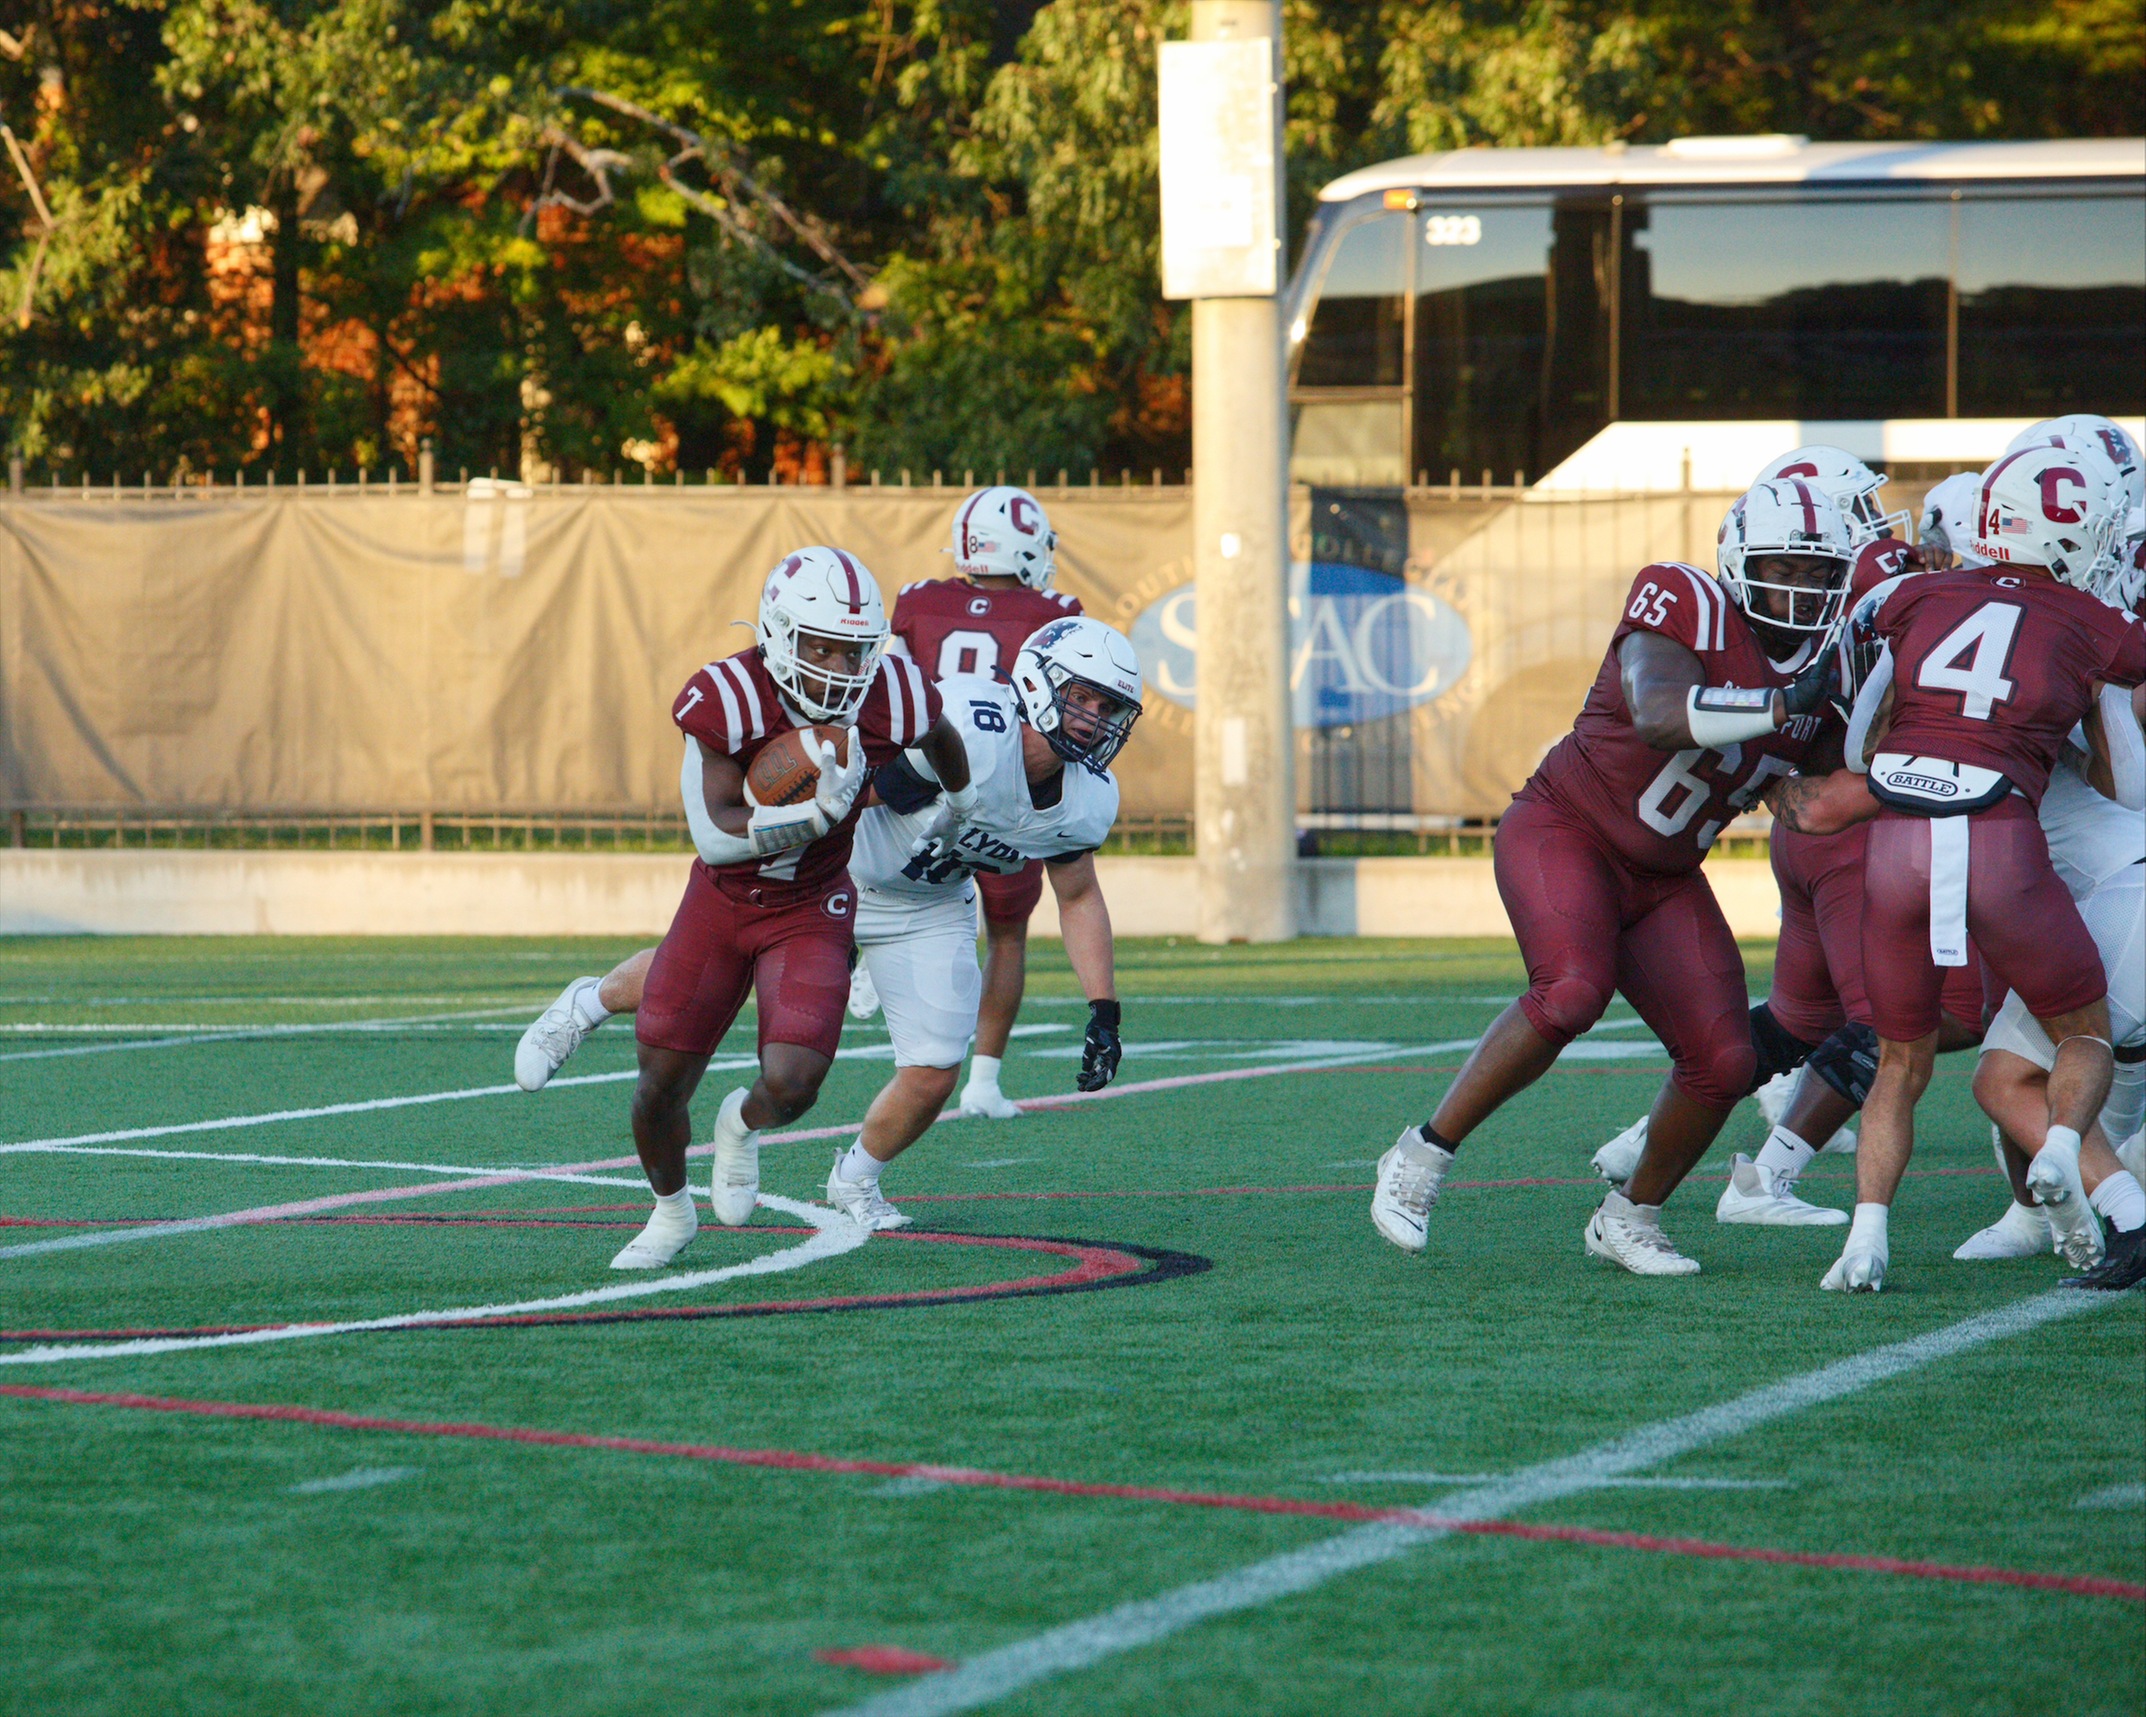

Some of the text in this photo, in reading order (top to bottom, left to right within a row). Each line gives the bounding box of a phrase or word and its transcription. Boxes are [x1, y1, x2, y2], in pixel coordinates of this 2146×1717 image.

[2040, 467, 2088, 523] C
[1010, 497, 1038, 535] C
[1988, 508, 2000, 535] 4
[969, 535, 978, 553] 8
[1996, 576, 2020, 588] C
[969, 598, 989, 615] C
[1628, 582, 1678, 626] 65
[1918, 601, 2022, 721] 4
[676, 686, 705, 722] 7
[969, 700, 1007, 734] 18
[1893, 774, 1953, 794] BATTLE
[827, 893, 849, 915] C
